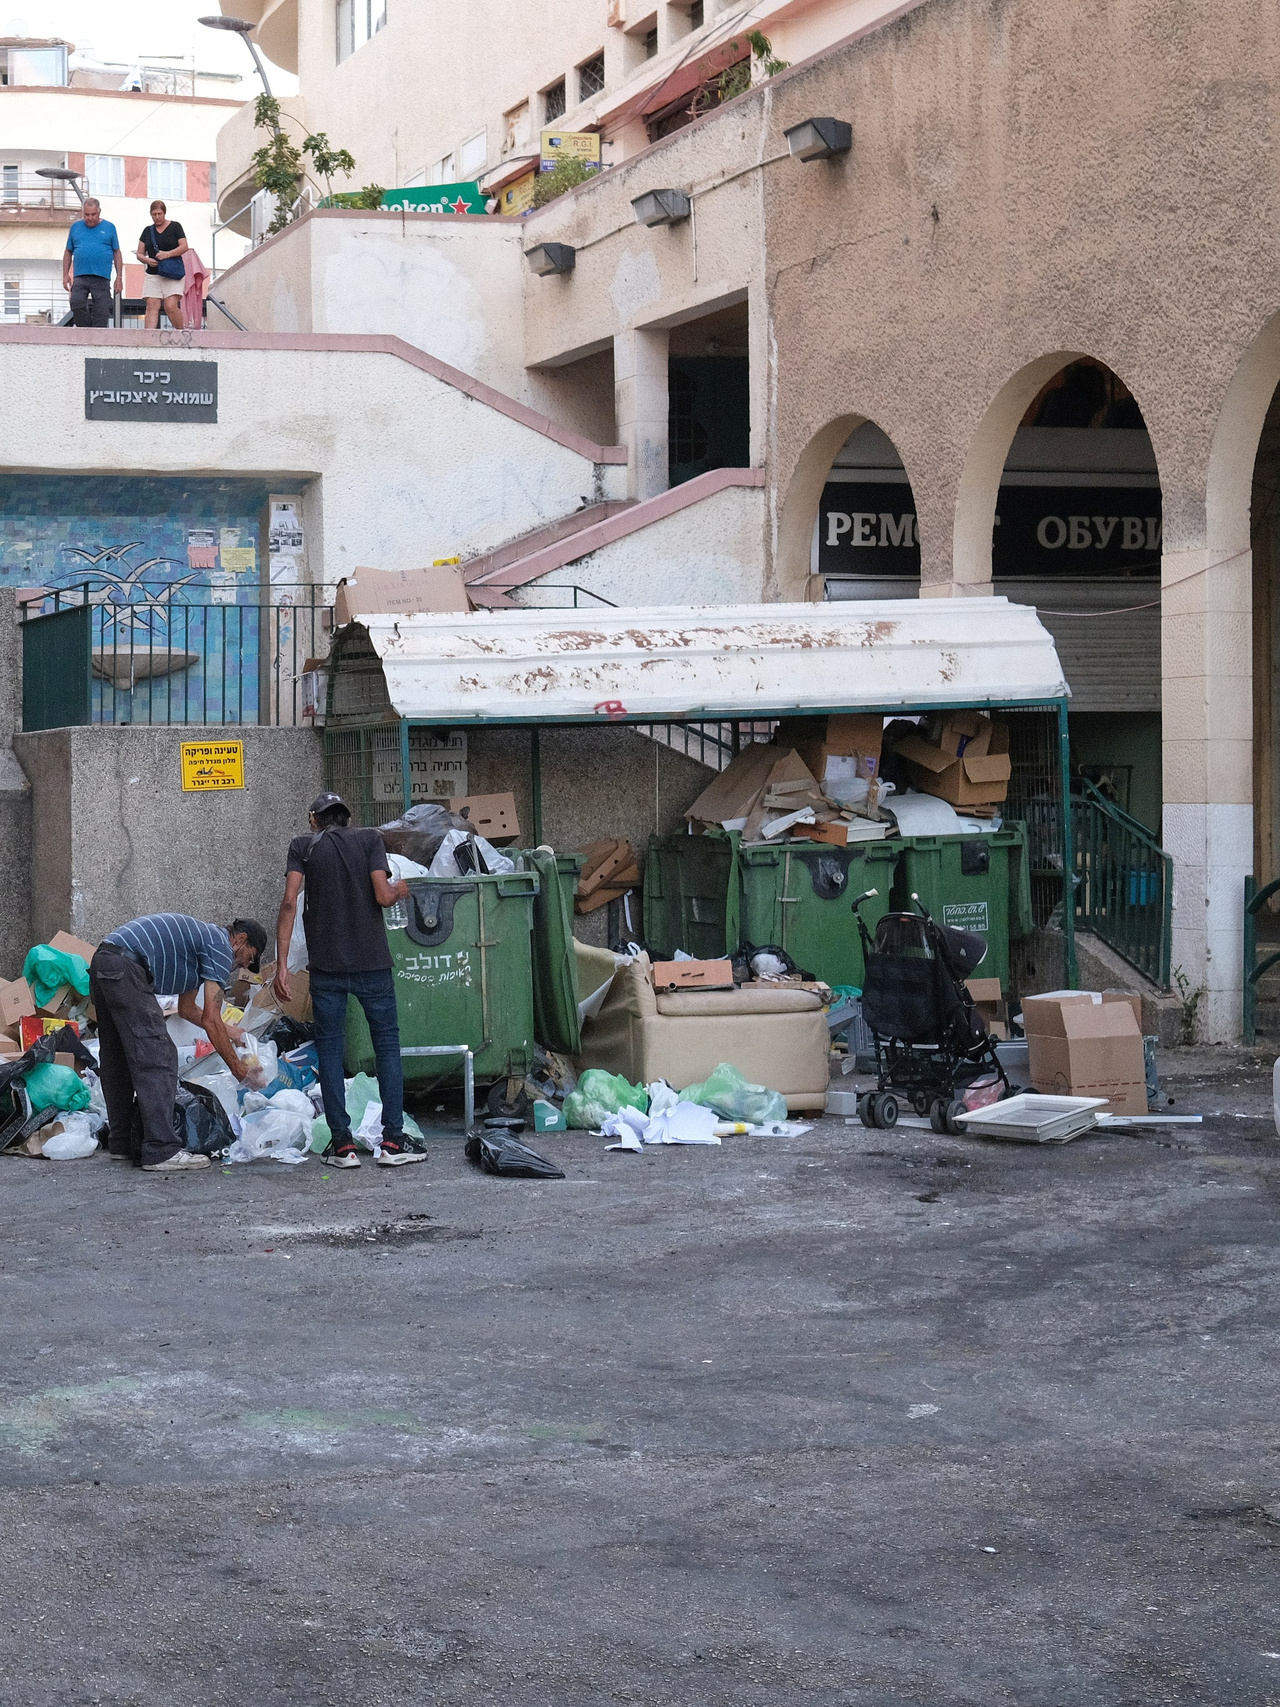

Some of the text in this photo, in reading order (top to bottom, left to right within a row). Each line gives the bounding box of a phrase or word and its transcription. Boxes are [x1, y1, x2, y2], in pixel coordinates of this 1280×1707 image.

[133, 371, 171, 384] כיכר
[89, 390, 214, 405] שמואל איצקוביץ
[384, 781, 428, 794] בתלום
[405, 953, 452, 970] דולב
